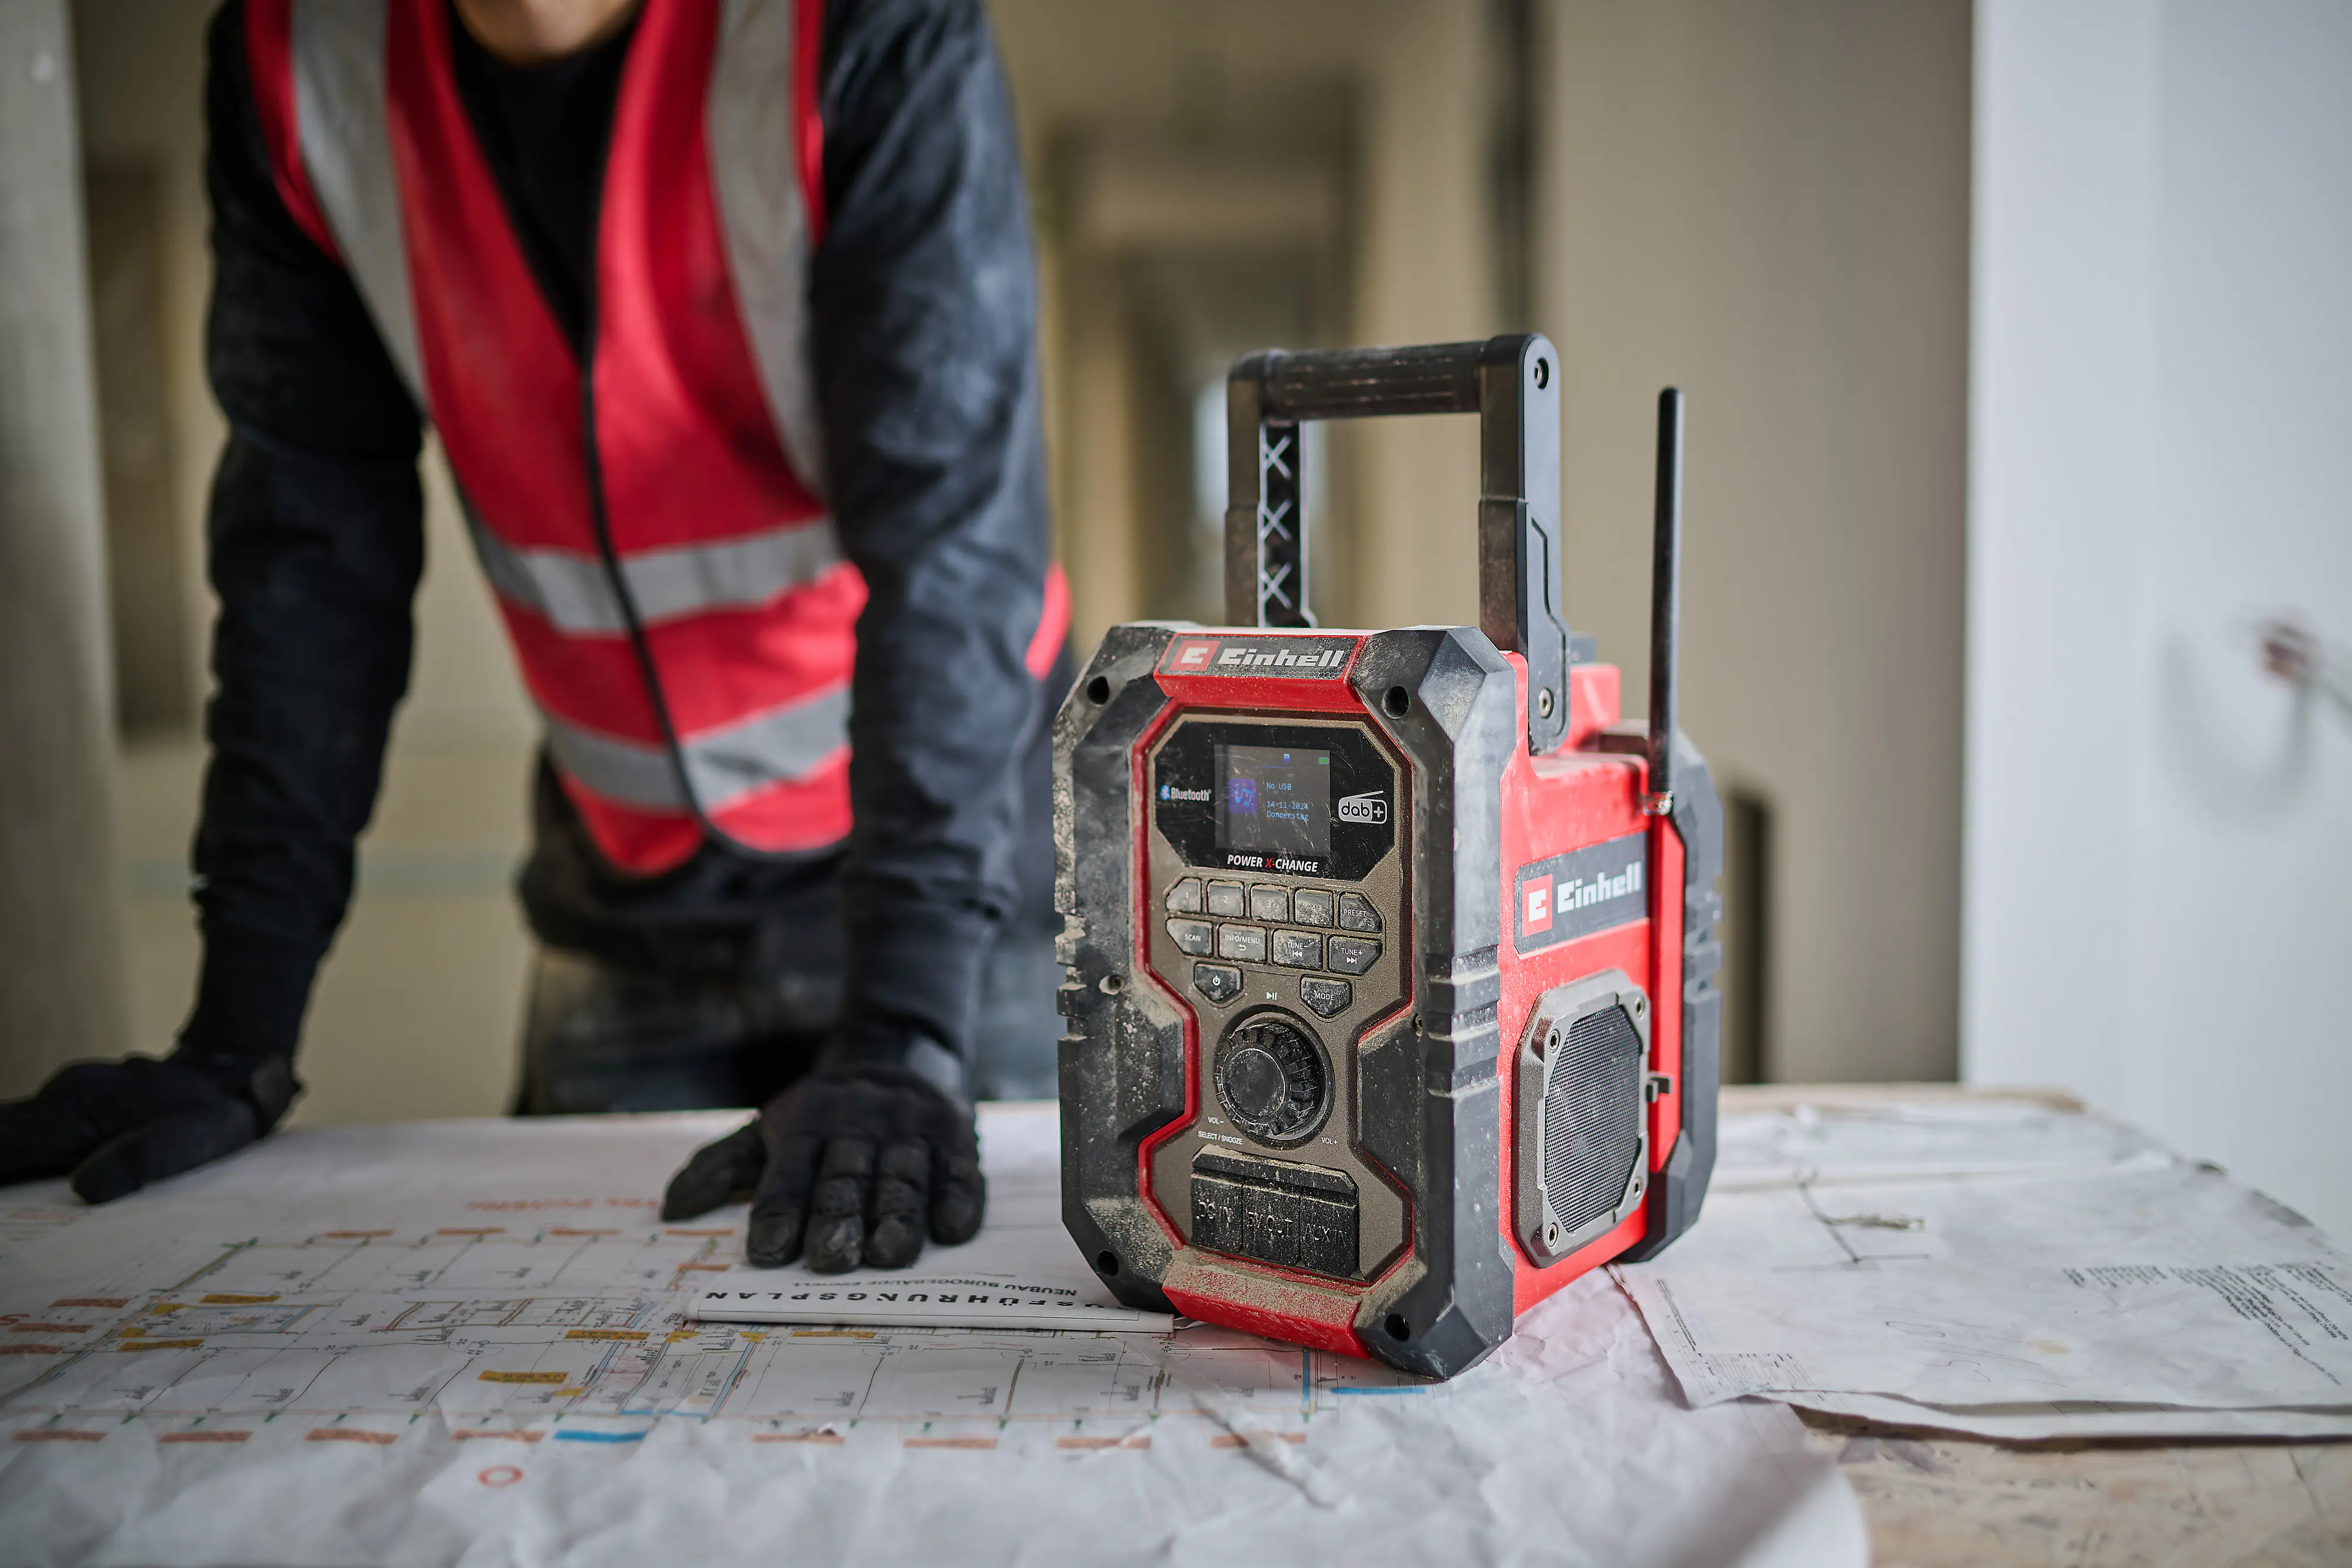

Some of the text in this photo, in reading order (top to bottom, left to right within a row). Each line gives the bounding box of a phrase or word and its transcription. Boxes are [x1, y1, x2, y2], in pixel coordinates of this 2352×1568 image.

[1218, 648, 1345, 668] Einhell
[1266, 800, 1309, 810] 14-11-2024
[1266, 810, 1309, 822] Donnerstag
[1227, 854, 1319, 872] POWER X-CHANGE
[1557, 861, 1642, 914] Einhell
[1185, 891, 1189, 900] 1
[1223, 895, 1228, 904] 2
[1266, 899, 1272, 908] 3
[1310, 904, 1316, 913] 4
[1343, 908, 1367, 918] PRESET
[1184, 933, 1201, 942] SCAN
[1225, 934, 1260, 944] INFO/MENU
[1340, 947, 1363, 956] TUNE+
[1315, 991, 1335, 1001] MODE
[1197, 1130, 1217, 1140] SELECT
[1221, 1135, 1243, 1145] SNOOZE
[1320, 1137, 1339, 1146] VOL+
[1005, 1283, 1077, 1297] NEUBAU
[705, 1292, 1132, 1310] USFÜHRUNGSPLAN
